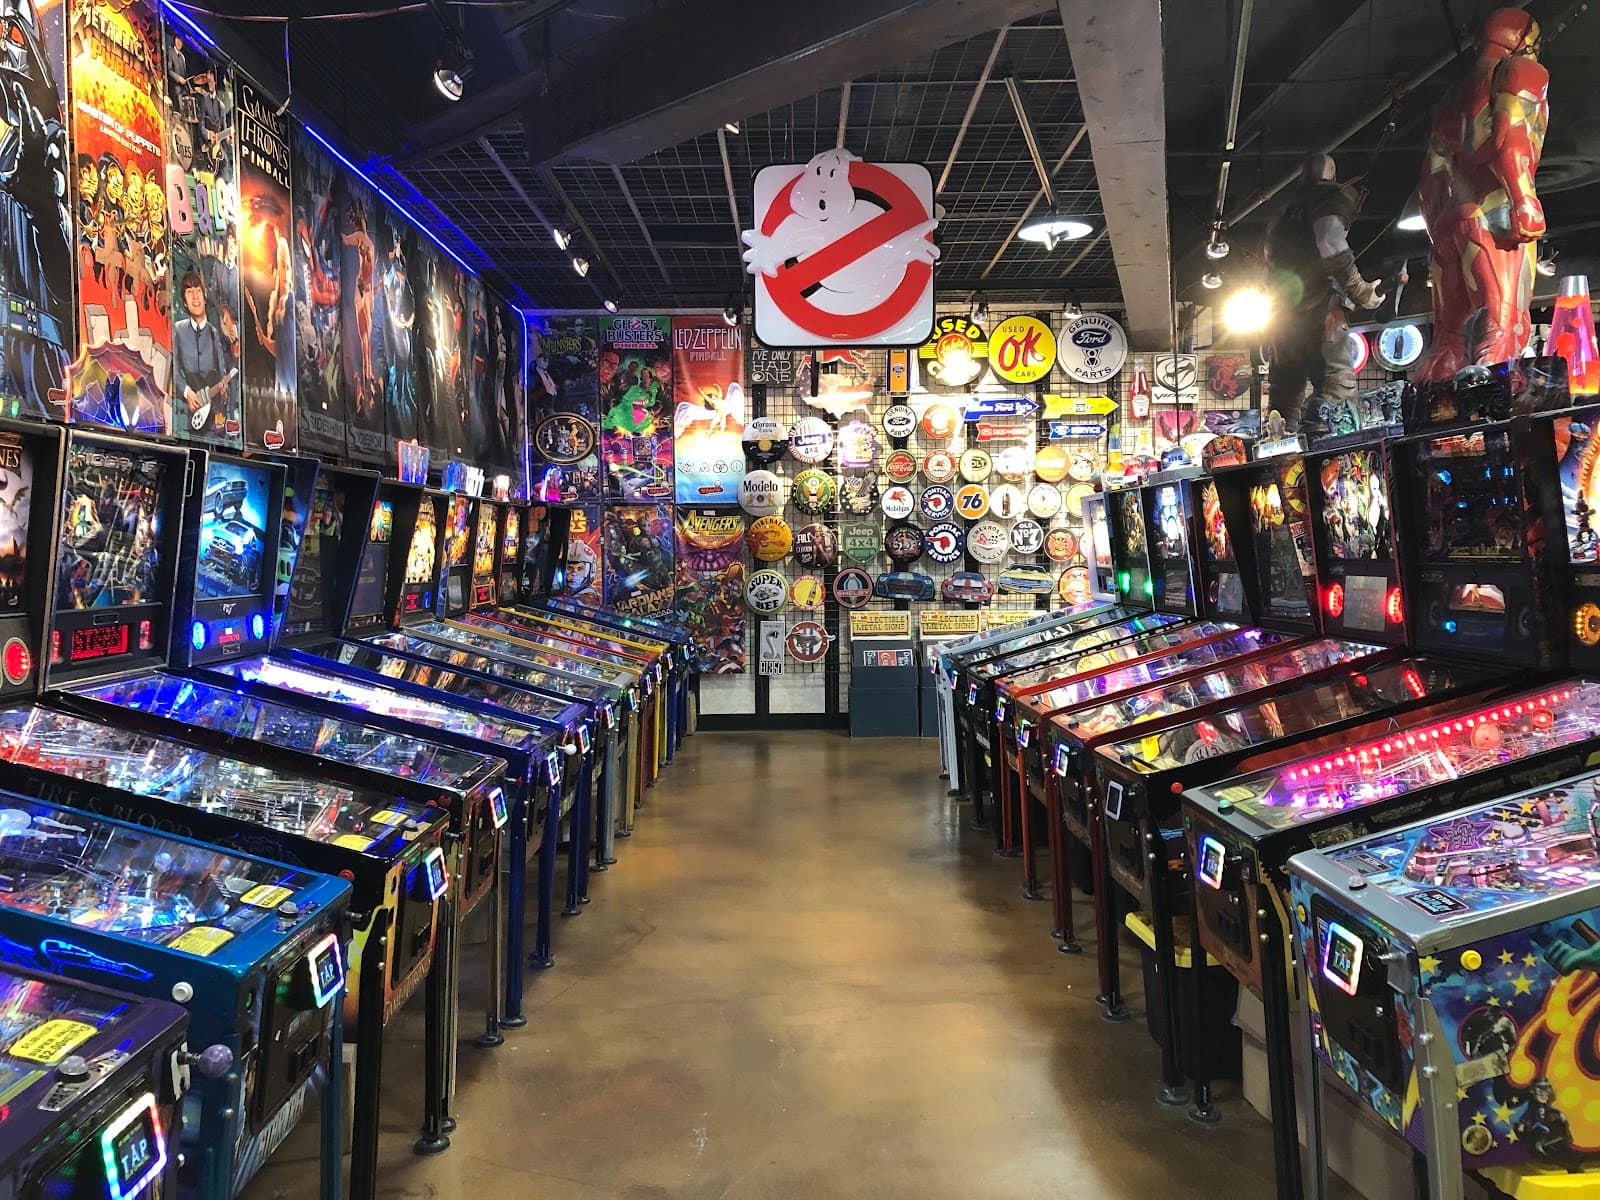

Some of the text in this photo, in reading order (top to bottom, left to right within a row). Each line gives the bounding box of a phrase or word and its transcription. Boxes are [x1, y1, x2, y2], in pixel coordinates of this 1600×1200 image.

[242, 85, 279, 136] GAME
[125, 130, 161, 157] PUPPETS
[240, 112, 289, 170] THRONES
[241, 147, 290, 189] PINBALL
[1069, 318, 1115, 334] GENUINE
[606, 330, 664, 342] BUSTERS
[1075, 332, 1107, 345] Ford
[999, 326, 1046, 371] OK
[689, 352, 727, 361] PINBALL
[752, 350, 792, 361] I'VE ONLY
[752, 361, 791, 371] HAD
[1074, 366, 1112, 378] PARTS
[752, 371, 791, 382] ONE
[1154, 392, 1197, 400] VIPER
[887, 407, 912, 416] GENUINE
[752, 421, 777, 429] Corona
[971, 459, 987, 468] OLT
[743, 480, 778, 492] Modelo
[924, 487, 951, 498] PONTIAC
[962, 494, 983, 509] 76
[924, 508, 950, 518] SERVICE
[684, 510, 741, 532] AVENGERS
[849, 527, 873, 536] Jeep
[929, 523, 962, 538] PONTIAC
[972, 526, 1005, 540] CHEVROLET
[849, 538, 874, 547] 4x4
[928, 549, 961, 562] SERVICE
[749, 574, 783, 593] SUPER
[756, 599, 779, 610] BEE
[1334, 955, 1351, 971] TAP
[320, 963, 335, 984] TAP
[121, 1138, 147, 1176] TAP
